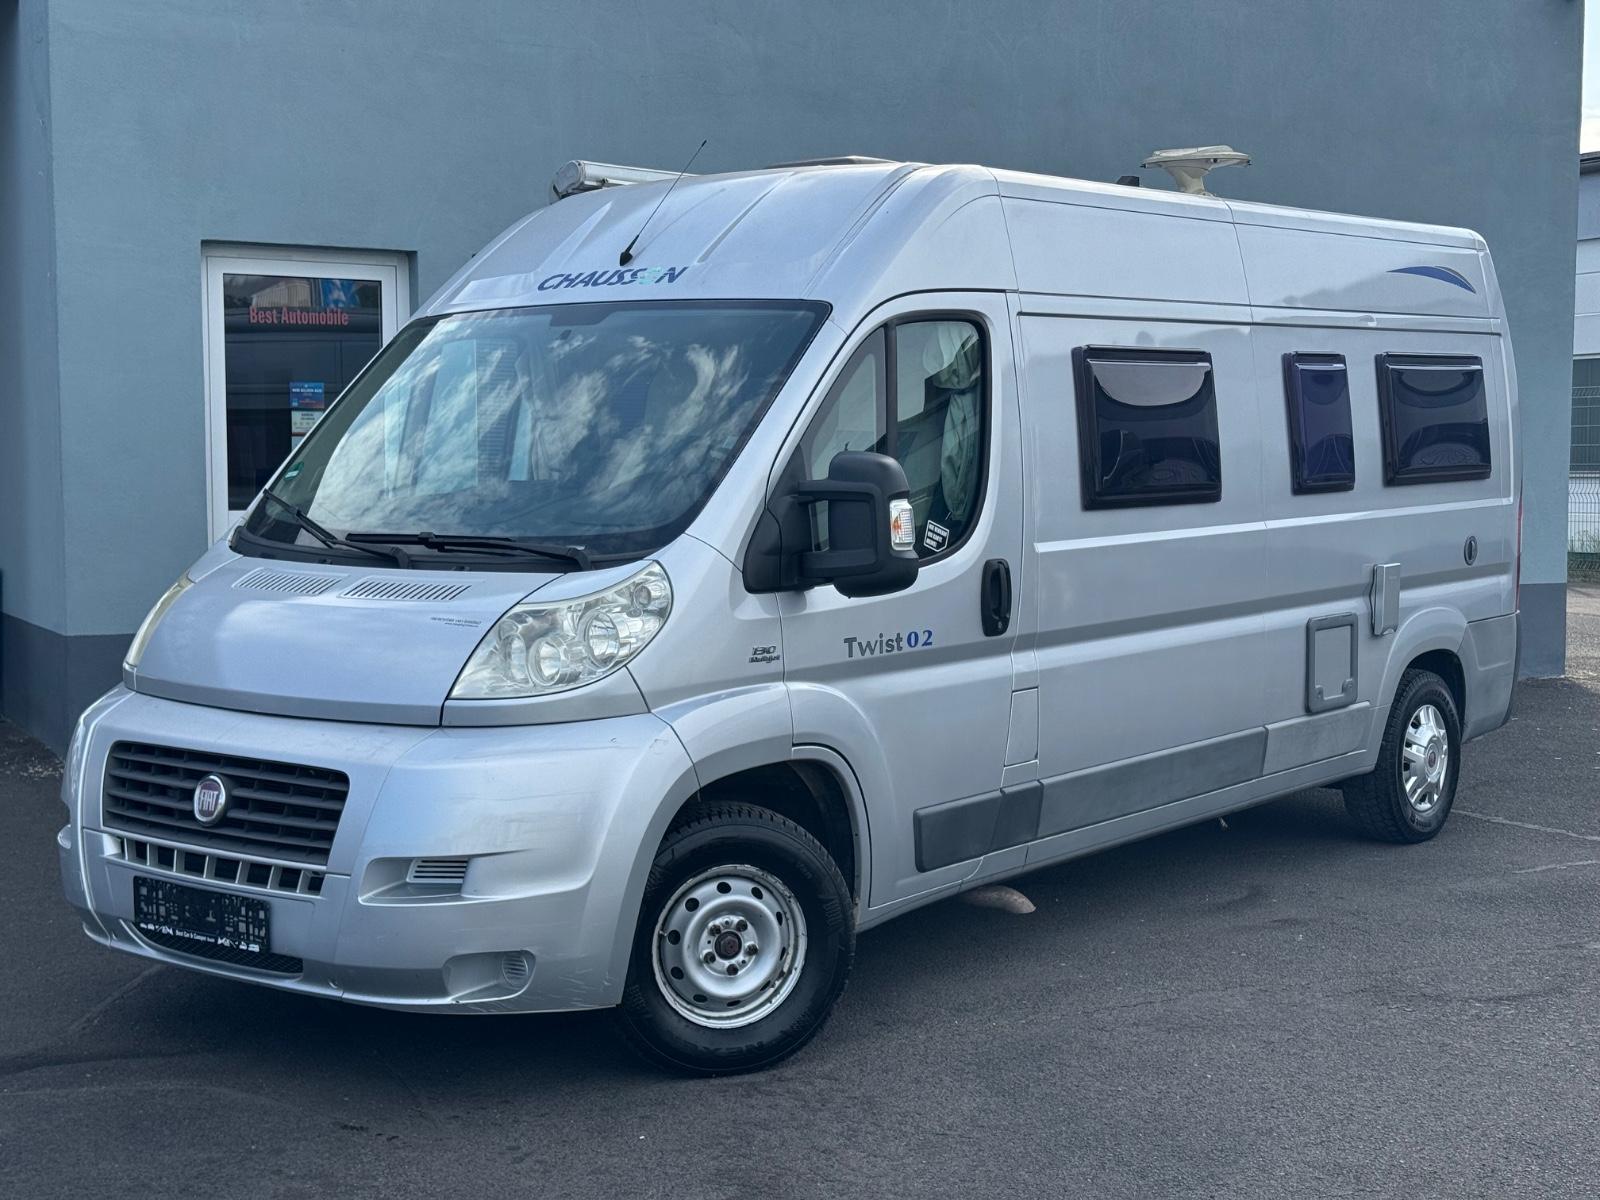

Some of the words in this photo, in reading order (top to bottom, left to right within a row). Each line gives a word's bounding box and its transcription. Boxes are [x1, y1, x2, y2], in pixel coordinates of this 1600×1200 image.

[249, 305, 278, 324] Best
[281, 305, 349, 325] Automobile
[844, 633, 903, 658] Twist
[907, 629, 933, 648] 02
[199, 789, 219, 811] FIAT
